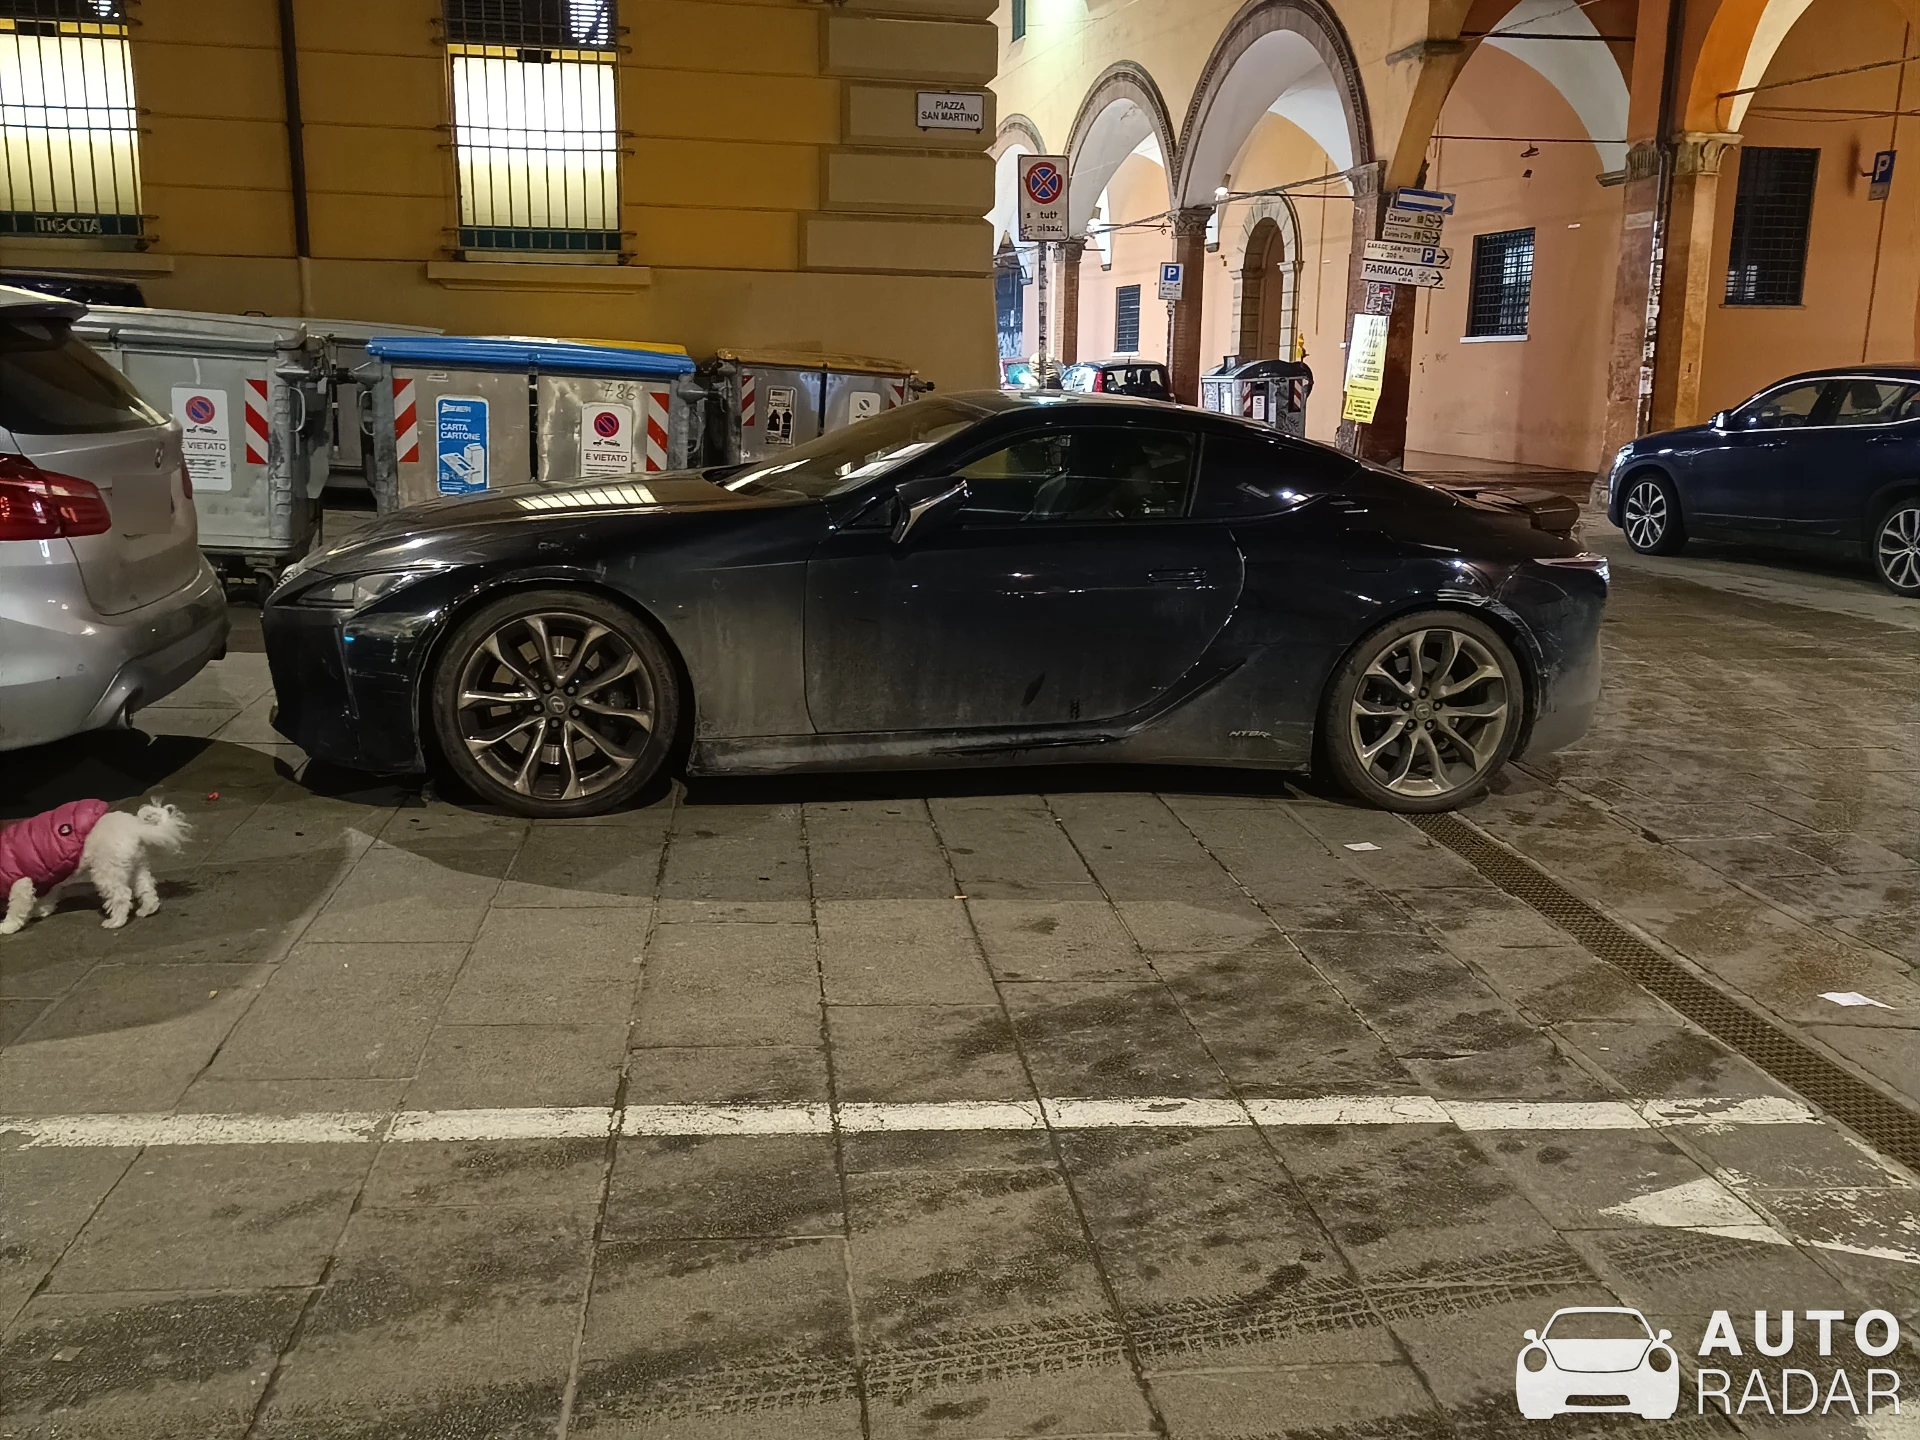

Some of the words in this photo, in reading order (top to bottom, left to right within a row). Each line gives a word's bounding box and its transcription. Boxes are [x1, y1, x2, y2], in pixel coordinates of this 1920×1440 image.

[935, 100, 965, 111] PIAZZA
[921, 110, 939, 120] SAN
[941, 112, 980, 122] MARTINO
[1364, 263, 1414, 277] FARMACIA
[440, 422, 469, 432] CARTA
[440, 431, 481, 441] CARTONE
[187, 441, 227, 451] VIETATO
[593, 453, 628, 462] VIETATO
